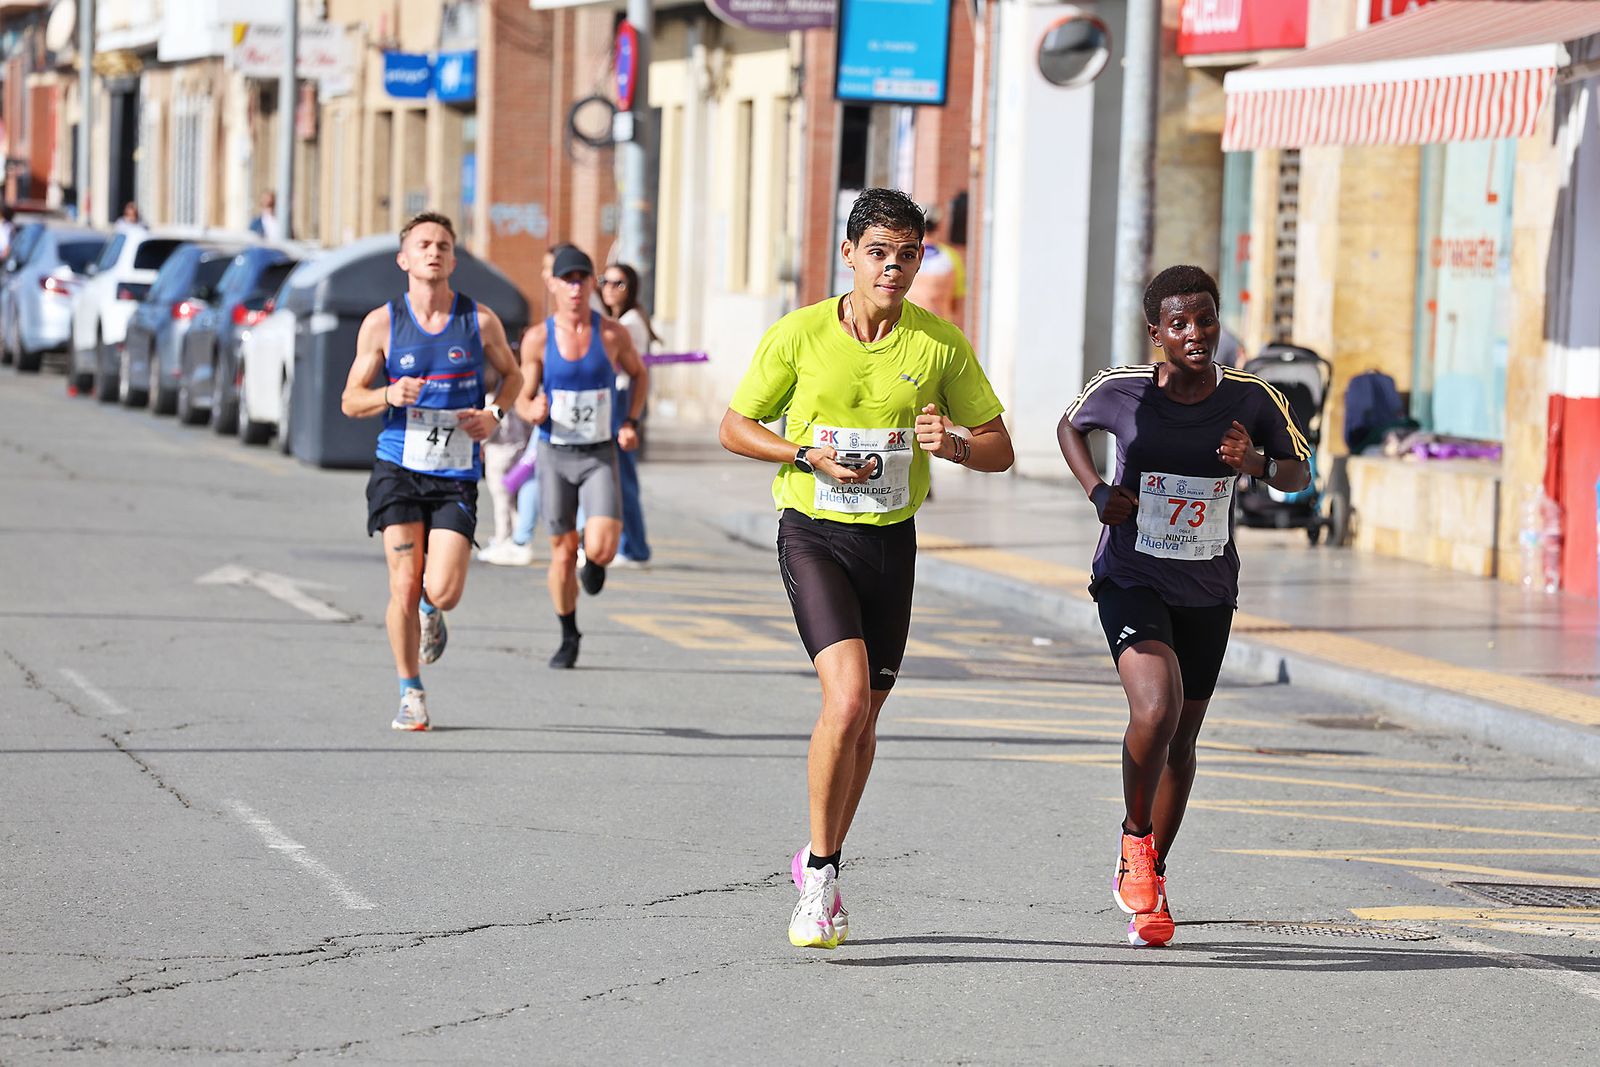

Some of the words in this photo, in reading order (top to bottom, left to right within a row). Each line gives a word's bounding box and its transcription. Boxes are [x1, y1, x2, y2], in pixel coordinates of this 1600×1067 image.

[572, 406, 593, 423] 32
[427, 427, 455, 446] 47
[820, 491, 859, 504] Huelva
[1168, 498, 1207, 528] 73
[1140, 535, 1180, 551] Huelva
[1165, 533, 1198, 542] NINTIJE
